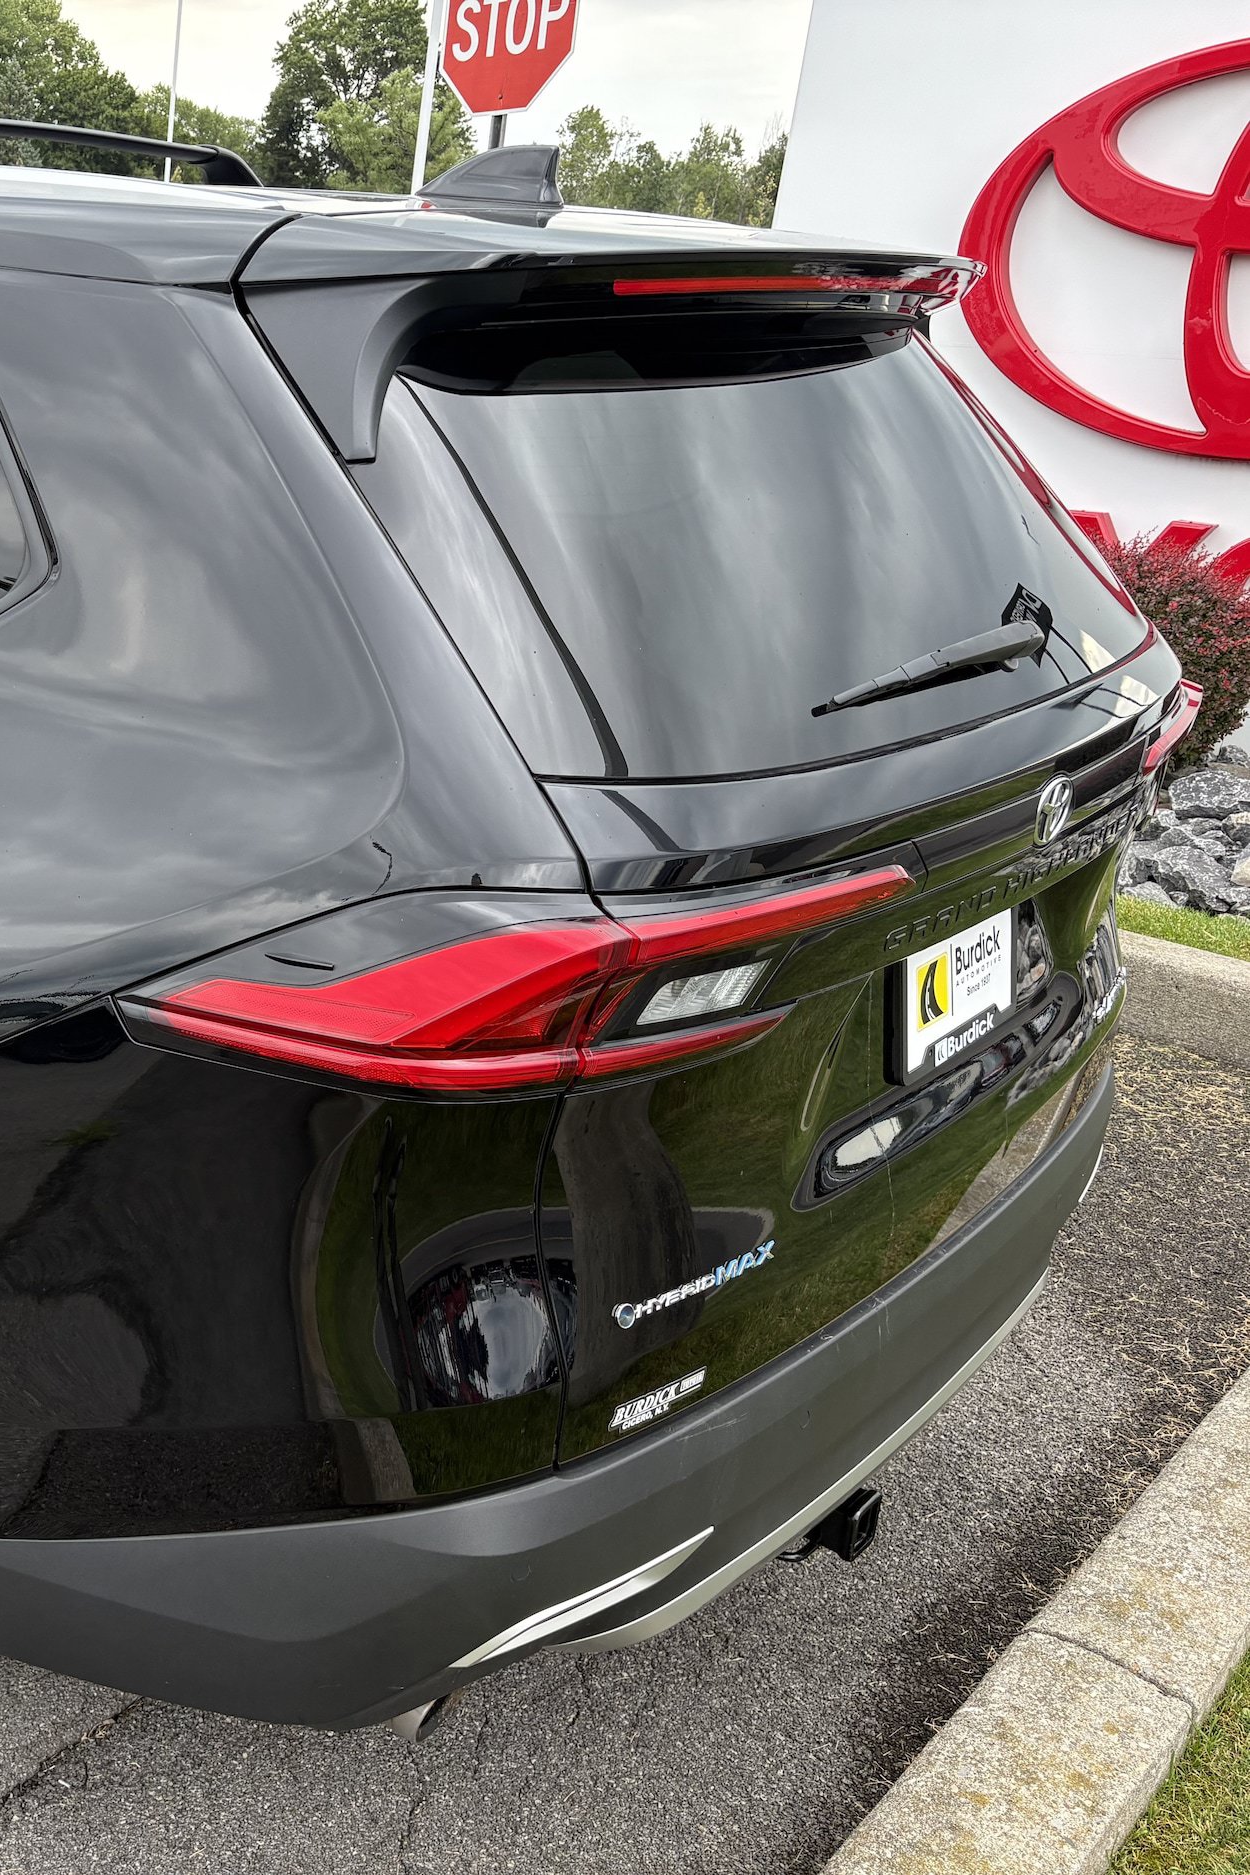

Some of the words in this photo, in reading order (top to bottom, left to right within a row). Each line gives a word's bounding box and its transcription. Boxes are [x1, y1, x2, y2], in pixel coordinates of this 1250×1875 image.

[452, 0, 570, 62] STOP
[884, 885, 998, 952] GRAND
[955, 925, 1001, 975] Burdick
[955, 954, 1002, 987] AUTOMOTIVE
[966, 981, 981, 997] Since
[946, 1011, 995, 1058] Burdick
[612, 1382, 681, 1425] BURDICK
